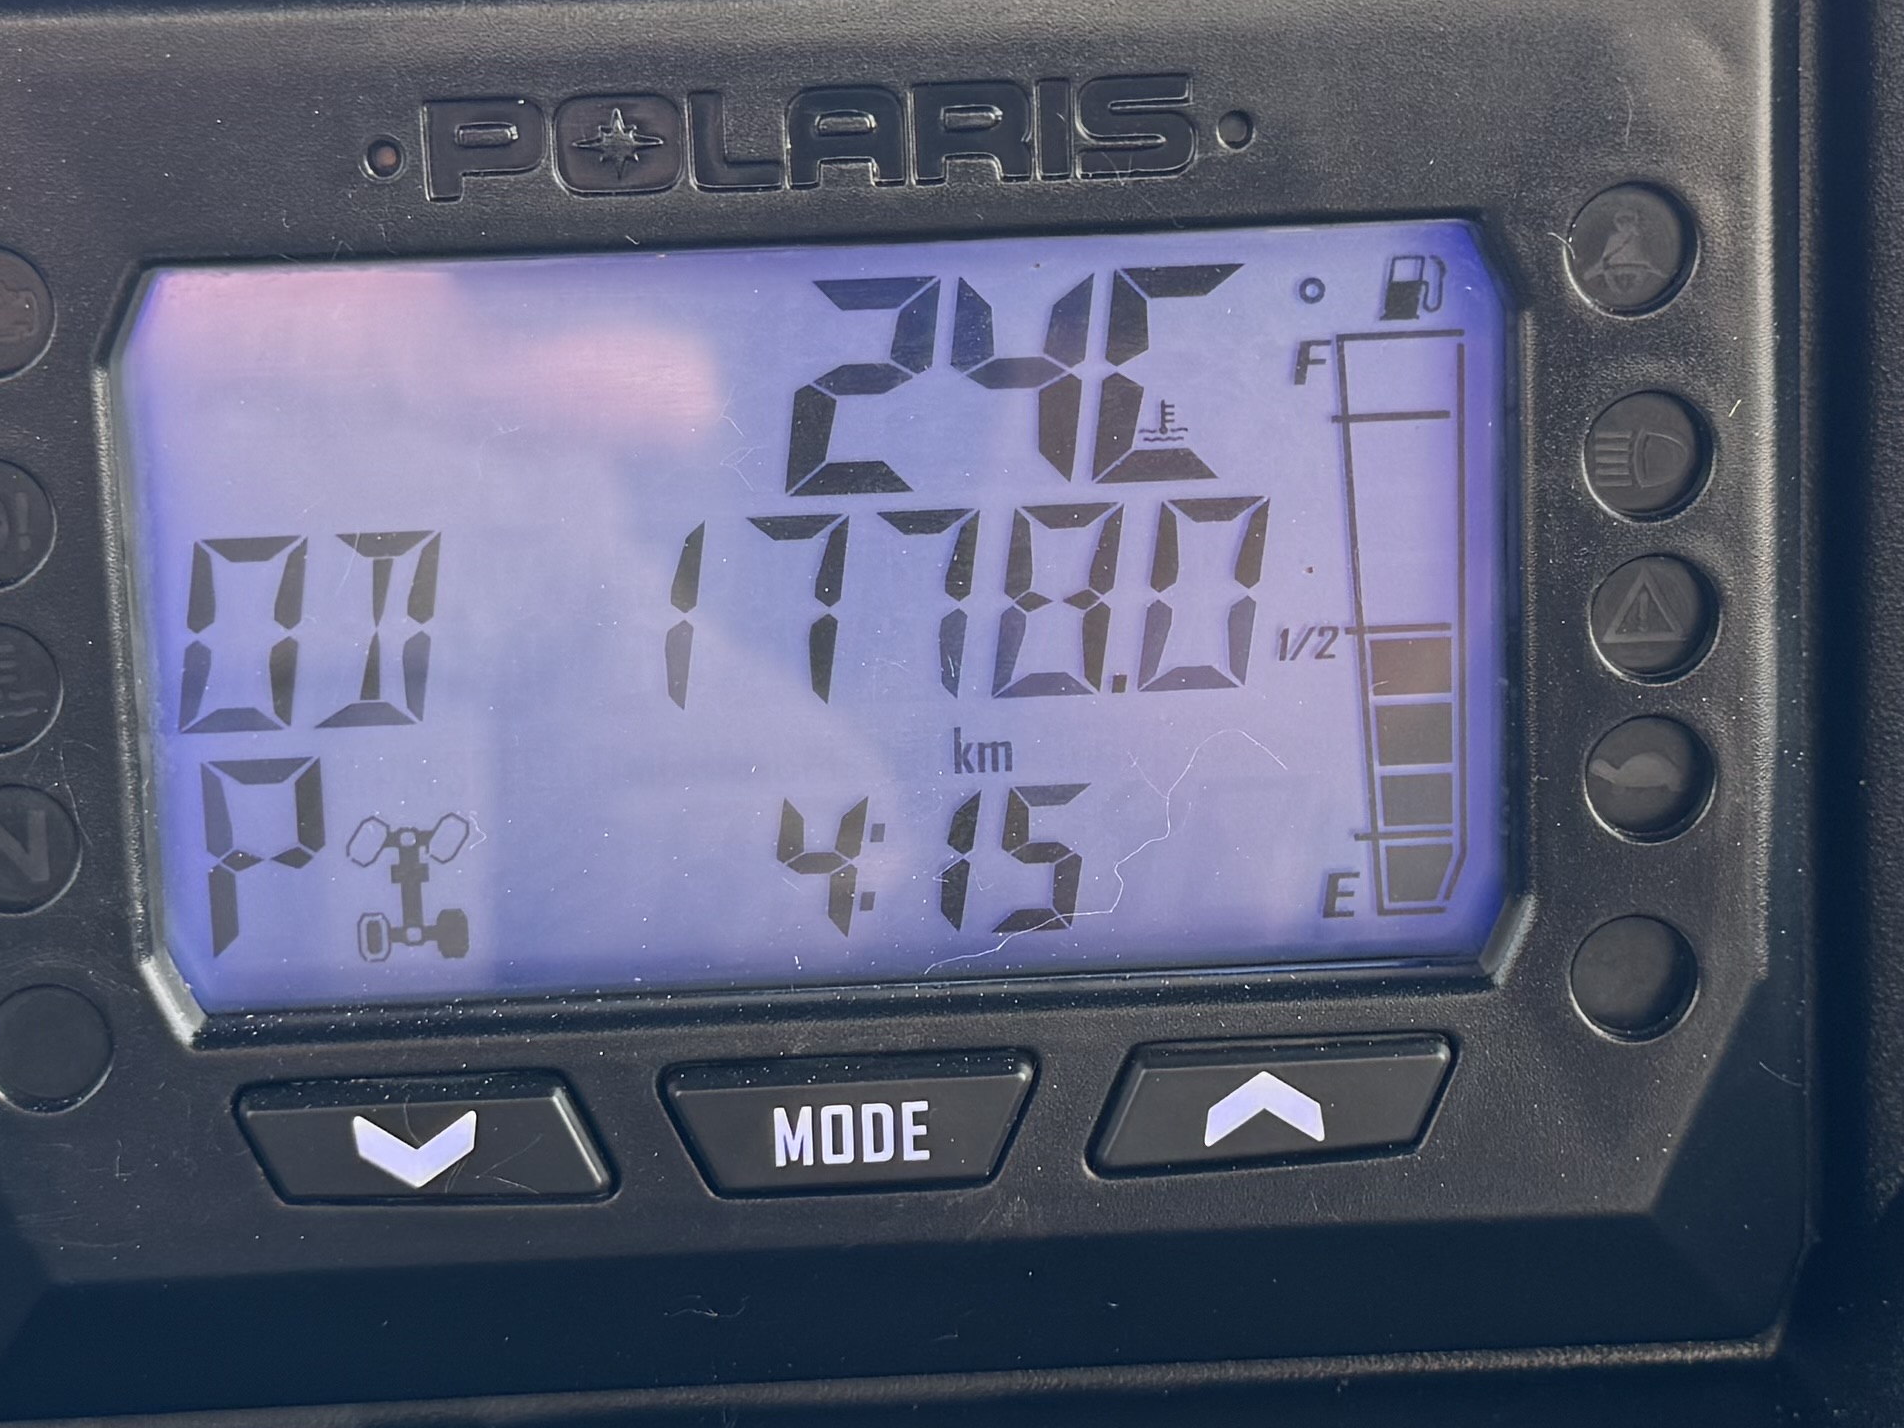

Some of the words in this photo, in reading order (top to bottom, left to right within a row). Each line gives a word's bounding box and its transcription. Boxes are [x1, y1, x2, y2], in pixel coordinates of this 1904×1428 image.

[421, 73, 1197, 203] POLARIS
[1295, 339, 1333, 386] F
[664, 495, 1270, 710] 1778.0
[1277, 626, 1340, 662] 1/2
[953, 726, 1014, 774] km
[200, 755, 327, 959] P
[776, 782, 1093, 938] 4:15
[1322, 871, 1361, 919] E
[773, 1100, 931, 1167] MODE
